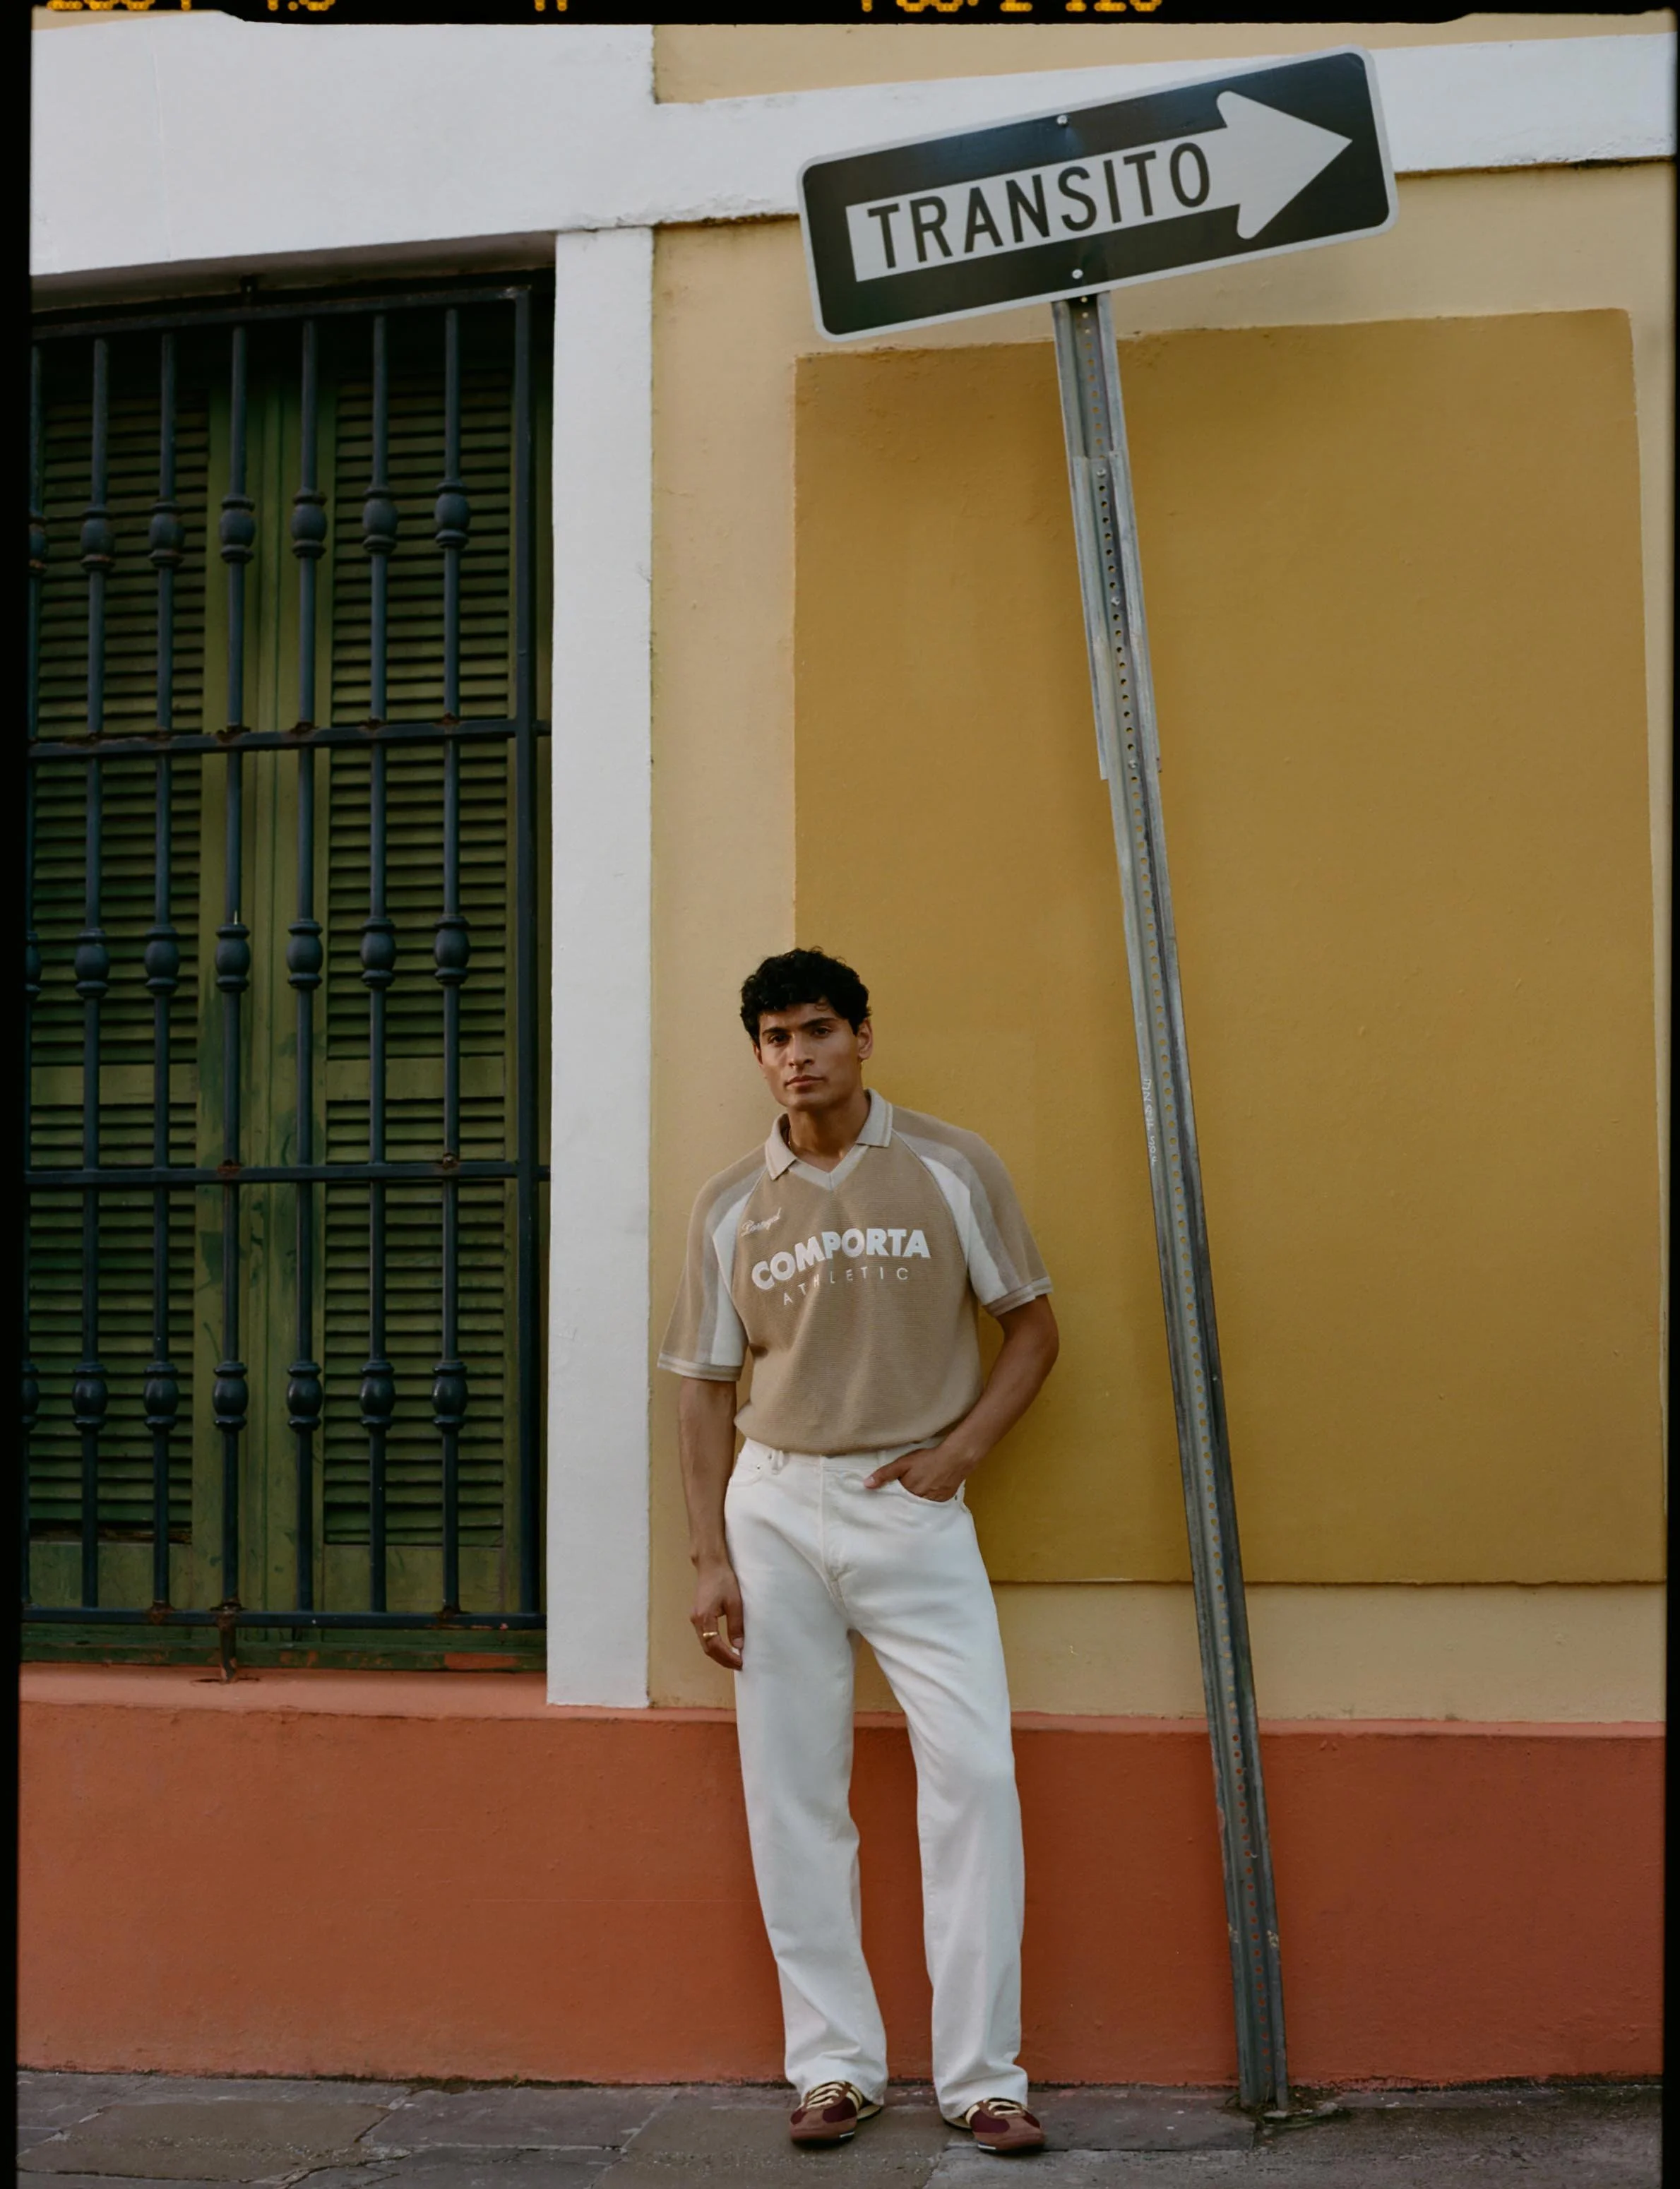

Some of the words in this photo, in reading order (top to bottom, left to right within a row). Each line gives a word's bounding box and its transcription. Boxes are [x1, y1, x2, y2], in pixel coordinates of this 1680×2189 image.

[867, 142, 1210, 269] TRANSITO
[751, 1228, 931, 1290] COMPORTA
[783, 1266, 909, 1306] ATHLETIC
